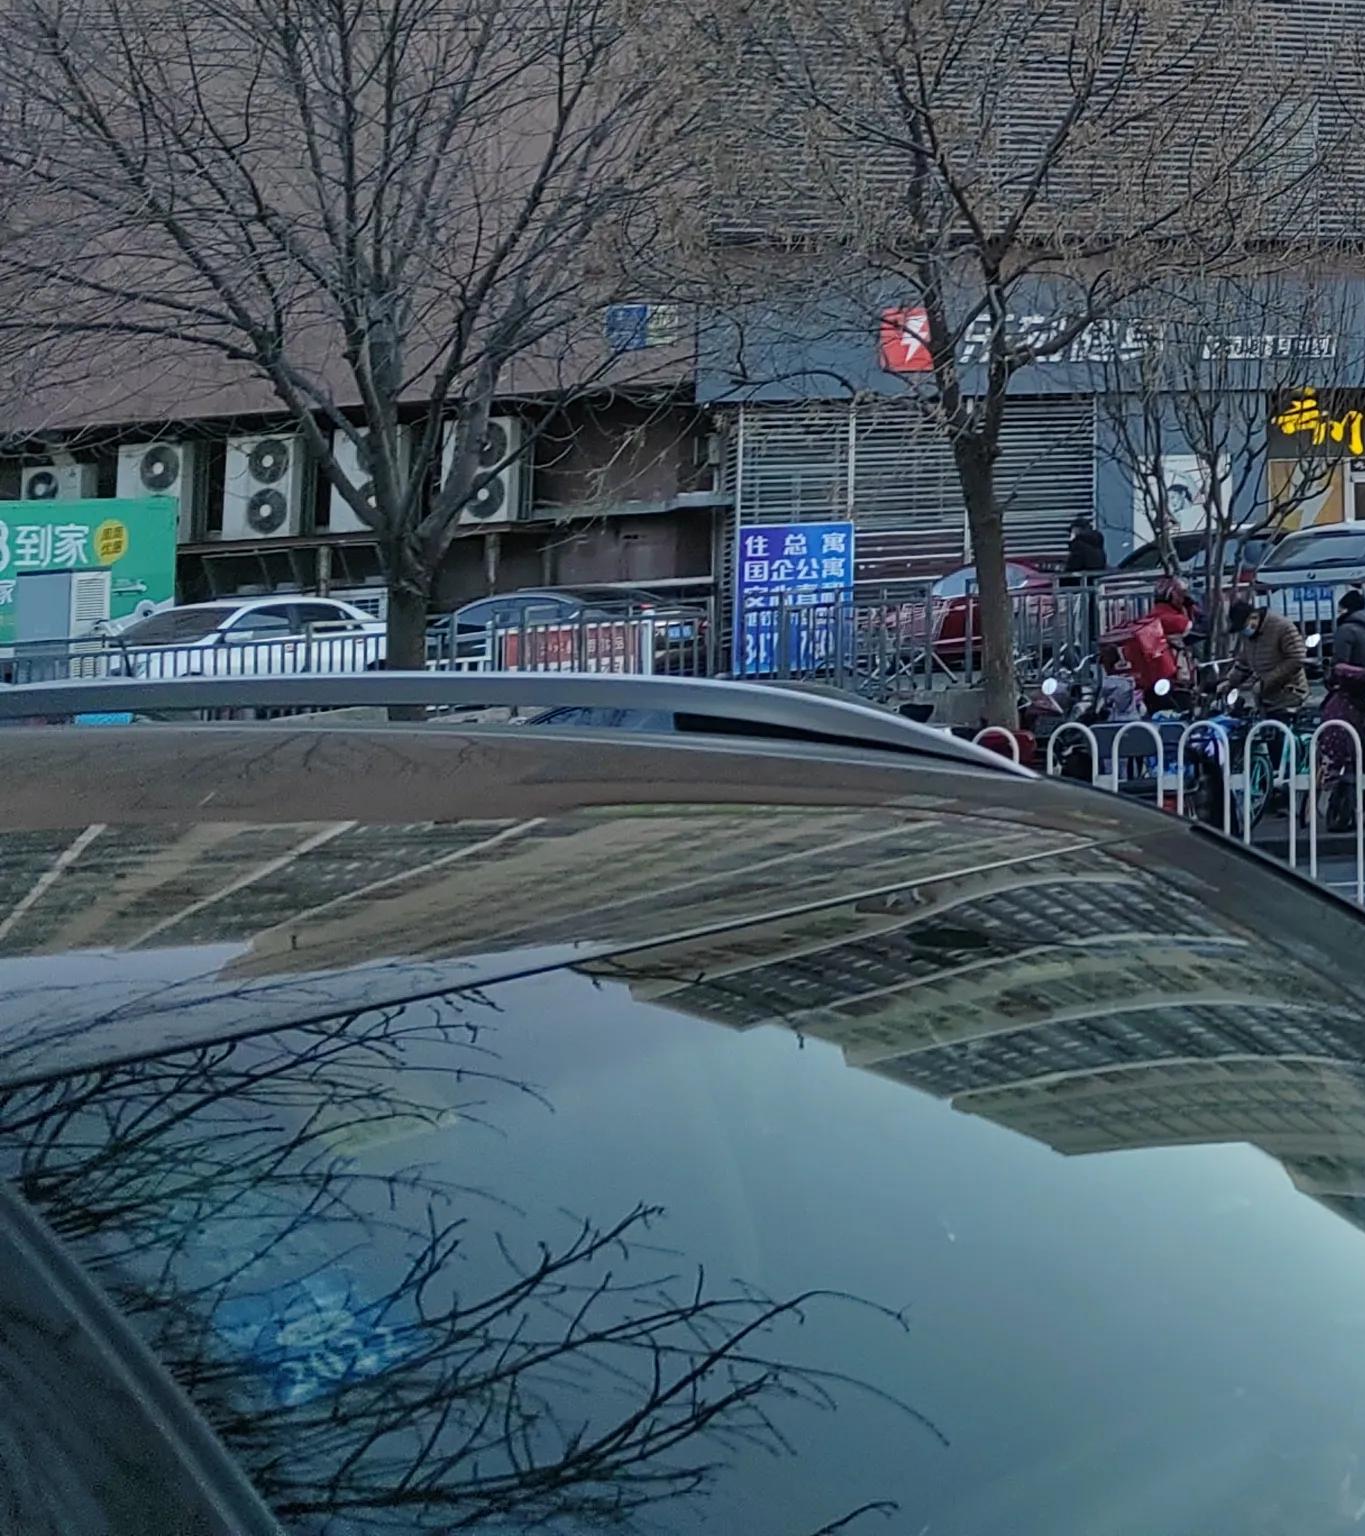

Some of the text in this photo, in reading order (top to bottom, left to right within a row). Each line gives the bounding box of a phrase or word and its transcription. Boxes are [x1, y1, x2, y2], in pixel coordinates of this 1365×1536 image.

[744, 532, 847, 557] 住总寓
[743, 557, 846, 583] 国企公寓
